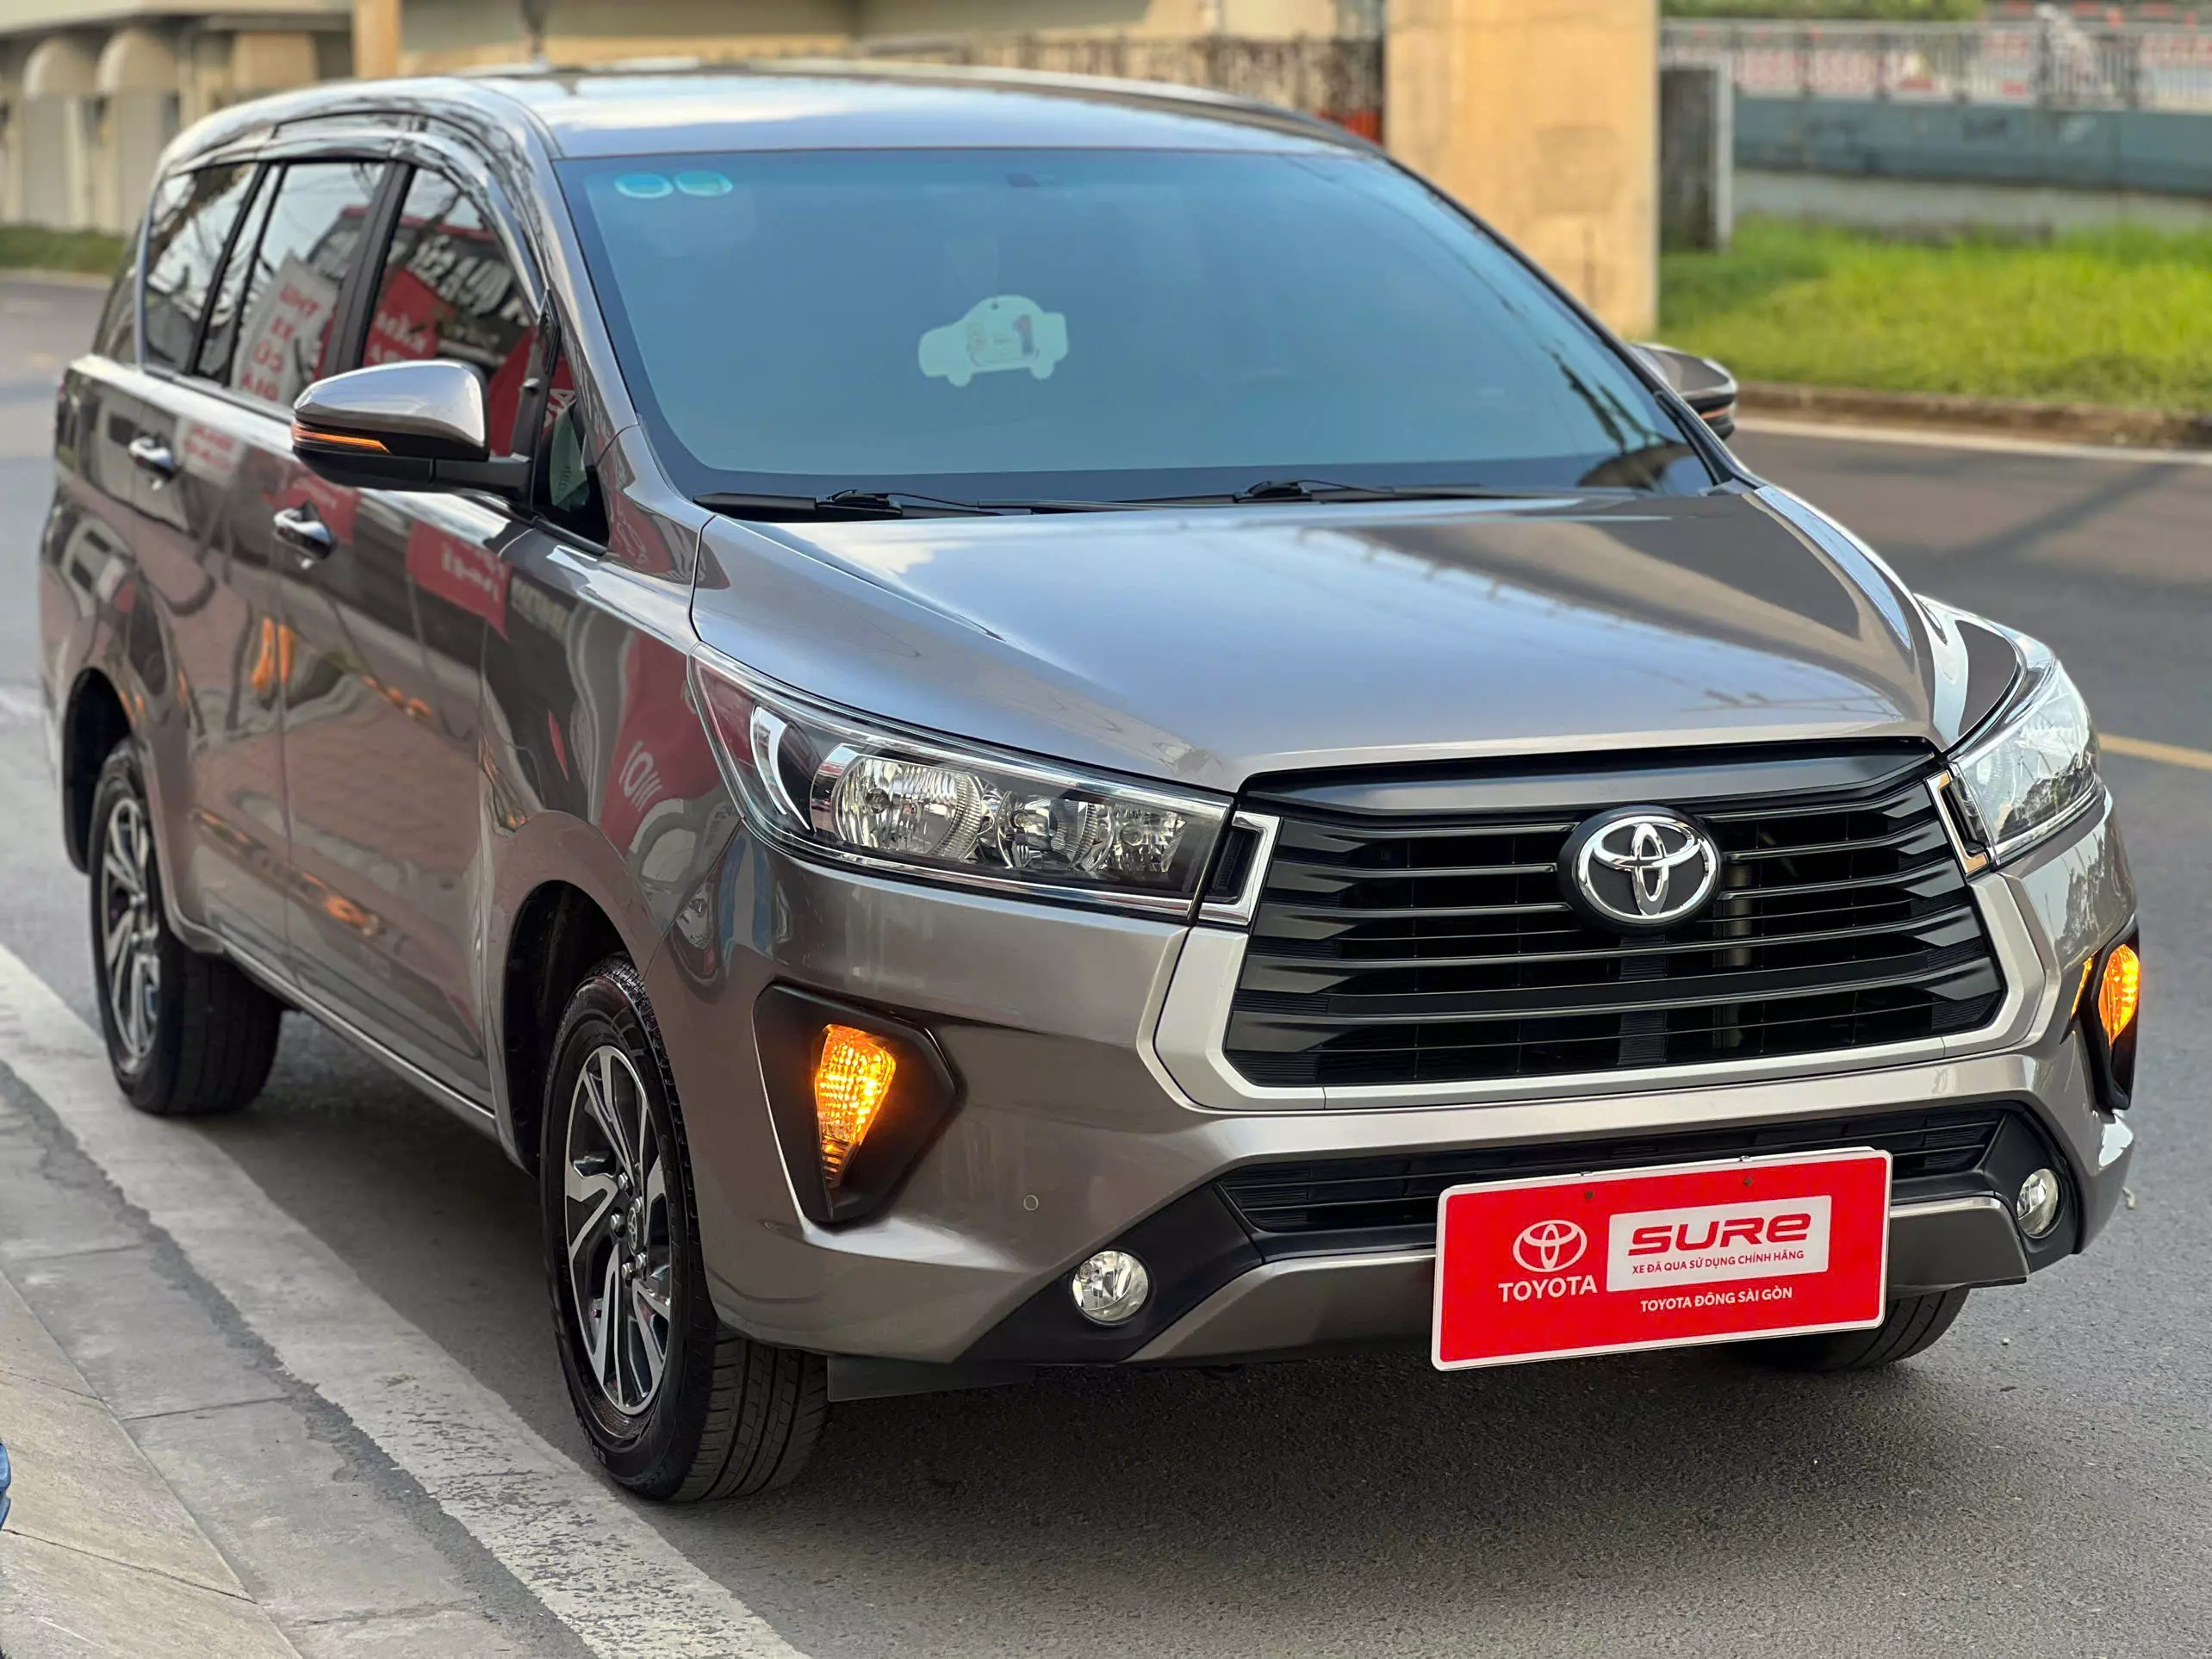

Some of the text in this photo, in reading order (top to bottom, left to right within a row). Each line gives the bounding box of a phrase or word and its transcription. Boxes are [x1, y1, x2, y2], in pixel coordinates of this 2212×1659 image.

[1632, 1250, 1804, 1275] XE ĐÃ QUA SỬ DỤNG CHÍNH HÃNG
[1498, 1275, 1597, 1302] TOYOTA
[1640, 1284, 1793, 1313] TOYOTA ĐÔNG SÀI GÒN
